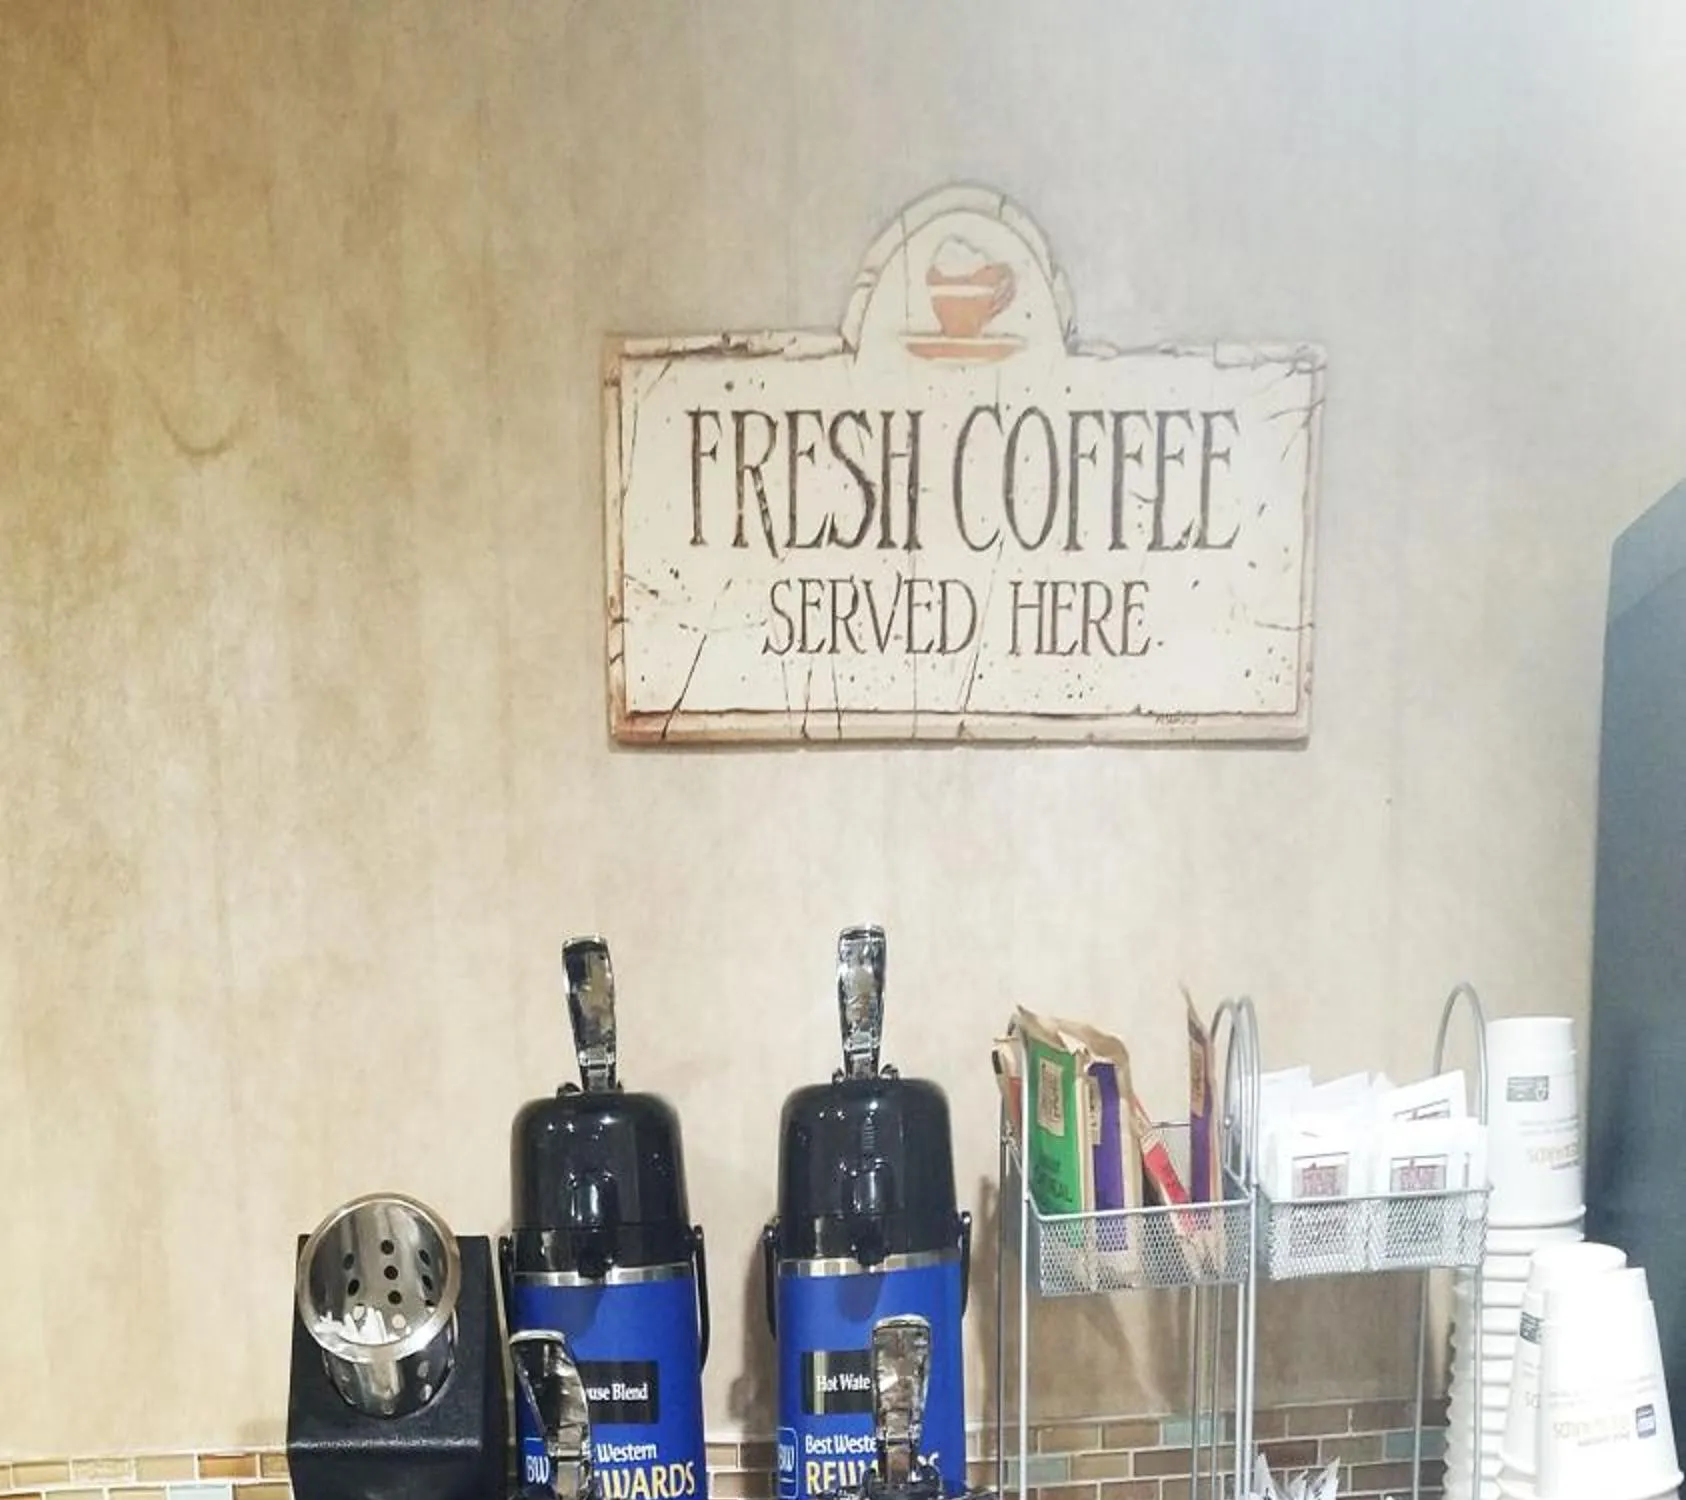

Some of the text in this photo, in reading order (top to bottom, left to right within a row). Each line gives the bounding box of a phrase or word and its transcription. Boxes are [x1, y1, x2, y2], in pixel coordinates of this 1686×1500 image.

[686, 404, 1240, 558] FRESH COFFEE
[762, 574, 1150, 657] SERVED HERE
[587, 1383, 648, 1401] use Blend
[817, 1373, 872, 1391] Hot Wate
[595, 1443, 658, 1463] Western
[805, 1435, 878, 1454] Best Weste
[594, 1461, 696, 1500] WARDS
